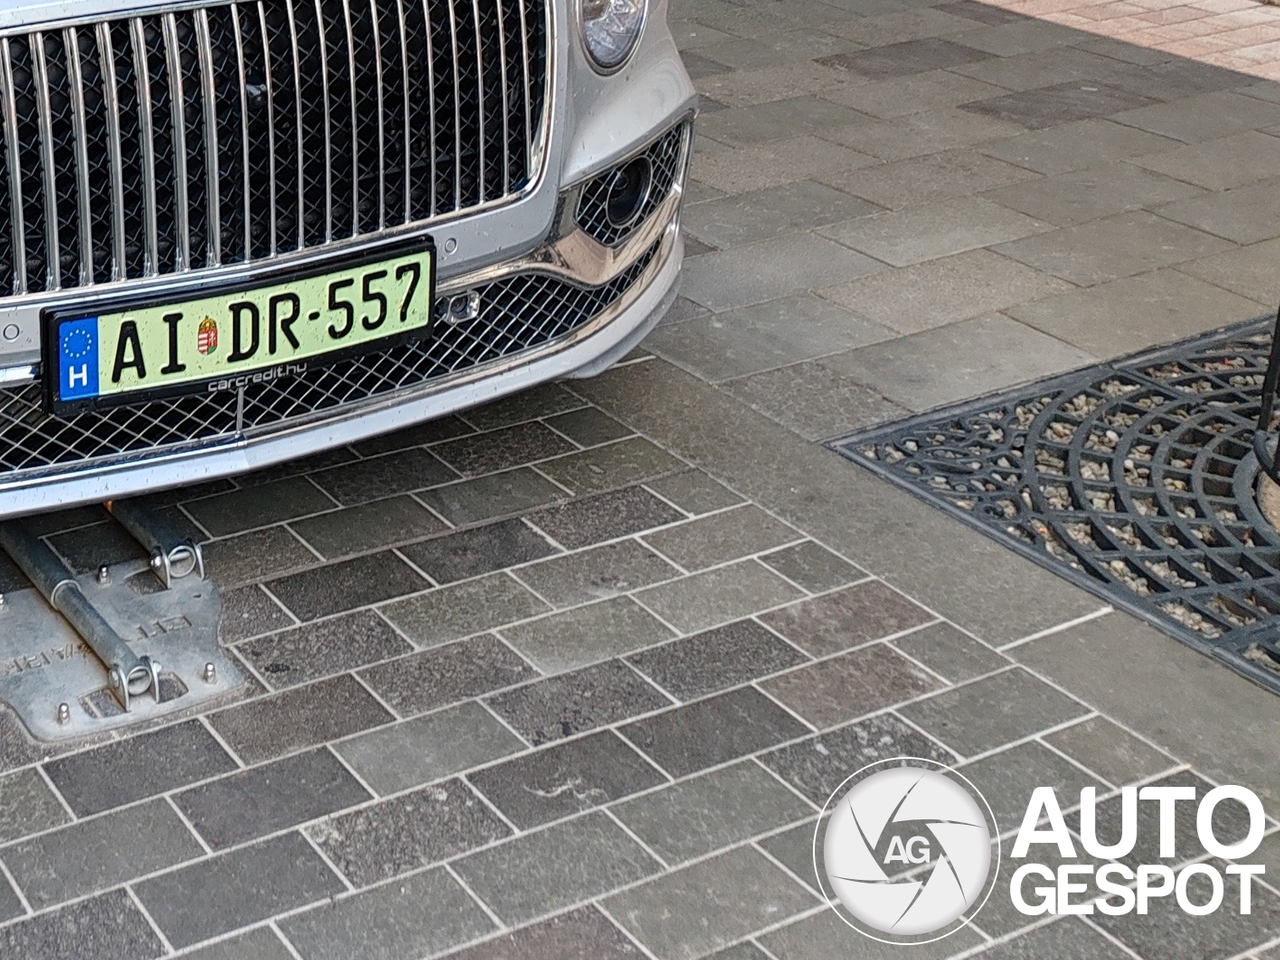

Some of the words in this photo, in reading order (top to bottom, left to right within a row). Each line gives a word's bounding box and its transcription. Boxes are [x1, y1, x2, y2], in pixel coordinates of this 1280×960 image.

[111, 312, 187, 383] AI
[226, 261, 421, 363] DR-557
[68, 363, 88, 389] H
[207, 362, 308, 392] carcredit.hu
